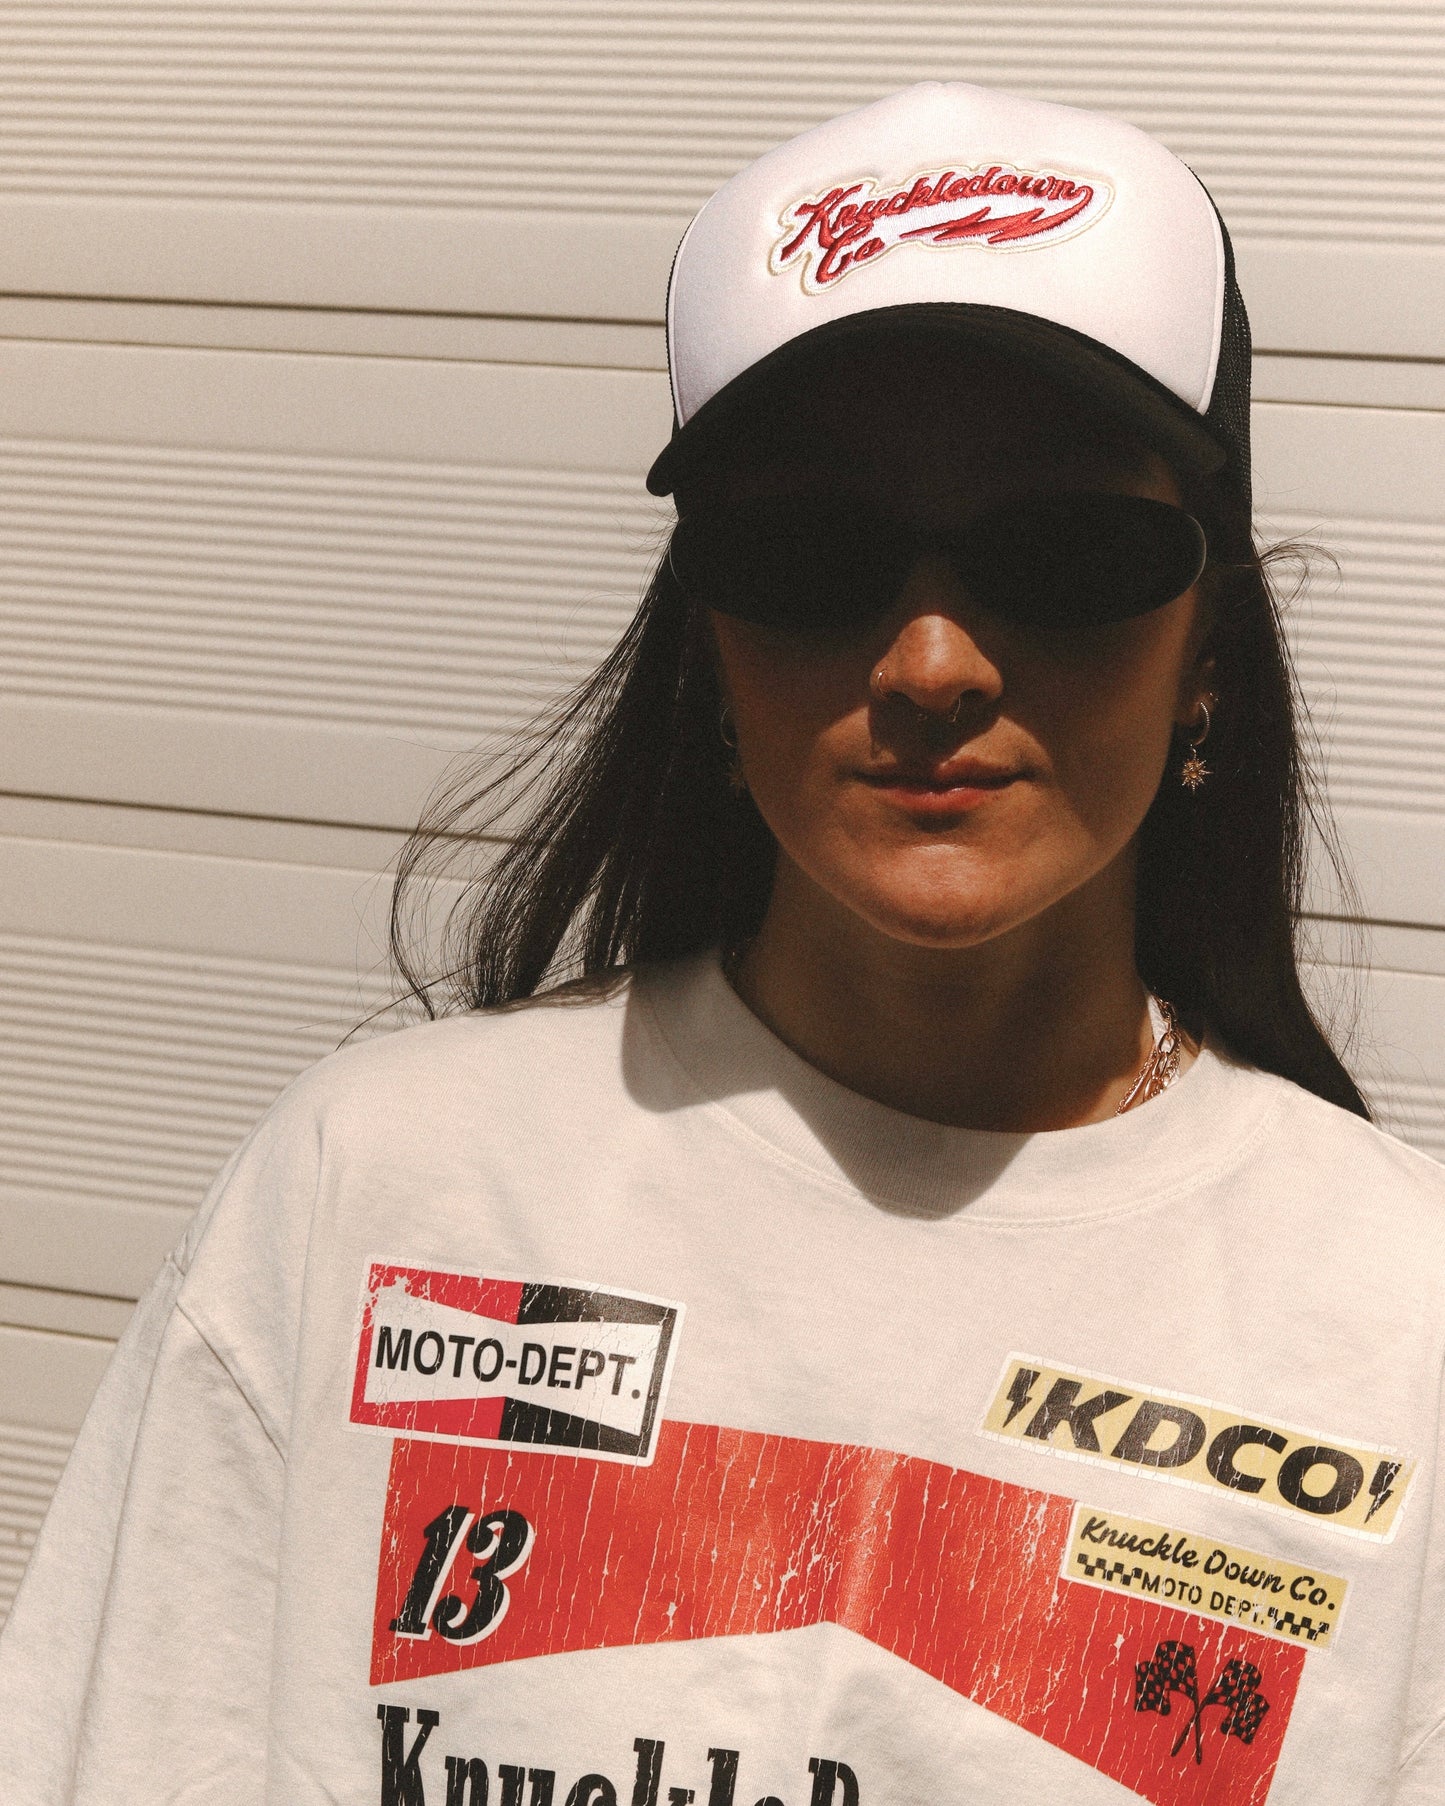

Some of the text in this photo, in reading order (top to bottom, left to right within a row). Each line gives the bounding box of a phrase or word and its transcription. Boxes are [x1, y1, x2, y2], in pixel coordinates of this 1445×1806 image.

[780, 166, 1094, 261] Knuckledown
[816, 220, 885, 284] Co
[375, 1325, 641, 1400] MOTO-DEPT.
[1023, 1377, 1365, 1516] KDCO
[389, 1505, 536, 1646] 13
[1080, 1516, 1336, 1611] Knuckle Down Co.
[1140, 1571, 1202, 1606] MOTO
